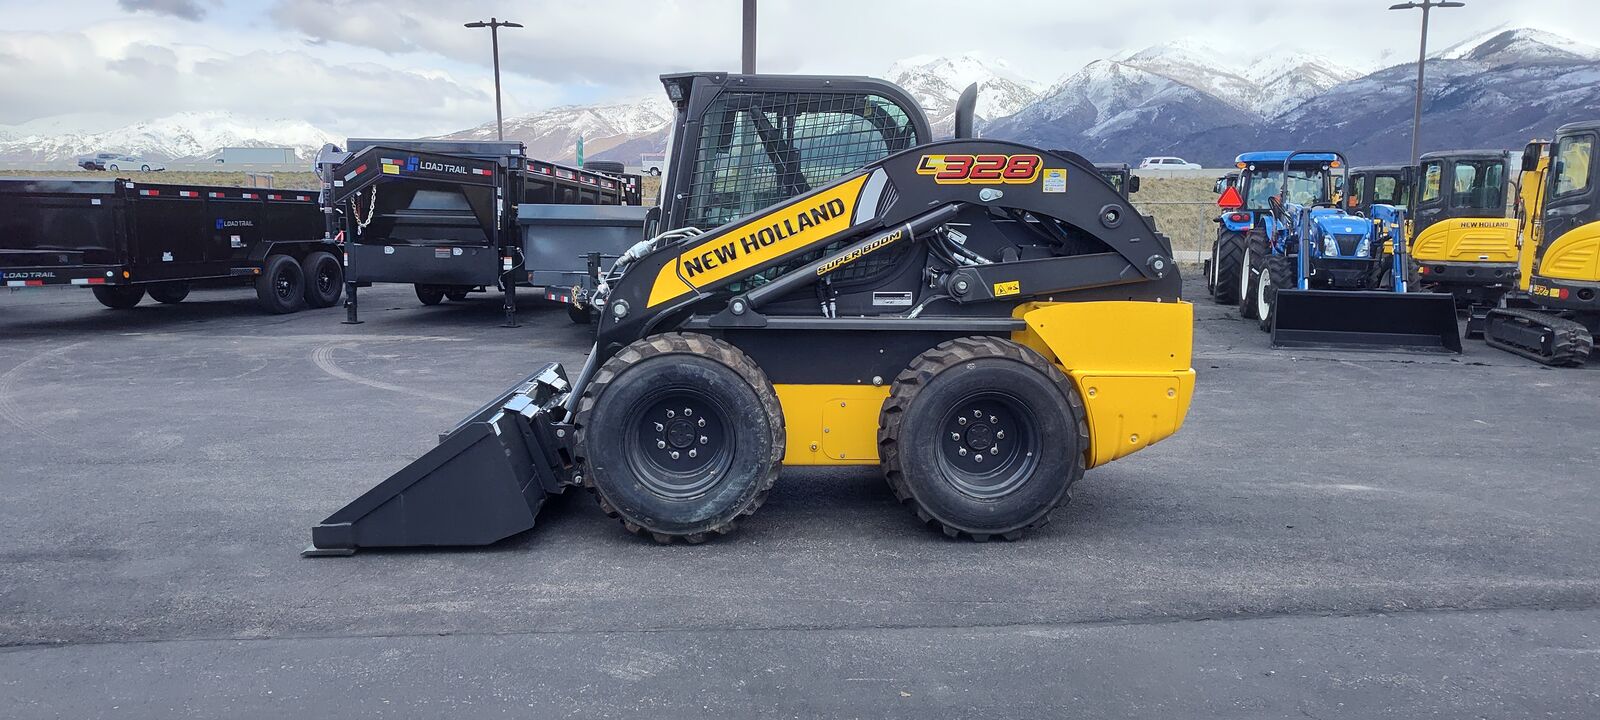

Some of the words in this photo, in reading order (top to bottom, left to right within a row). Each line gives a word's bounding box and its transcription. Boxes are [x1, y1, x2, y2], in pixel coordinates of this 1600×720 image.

[420, 161, 443, 171] LOAD
[445, 164, 468, 174] TRAIL
[916, 155, 1043, 184] L328
[684, 242, 737, 278] NEW
[740, 198, 845, 254] HOLLAND
[817, 248, 862, 275] SUPER
[862, 230, 901, 254] BOOM
